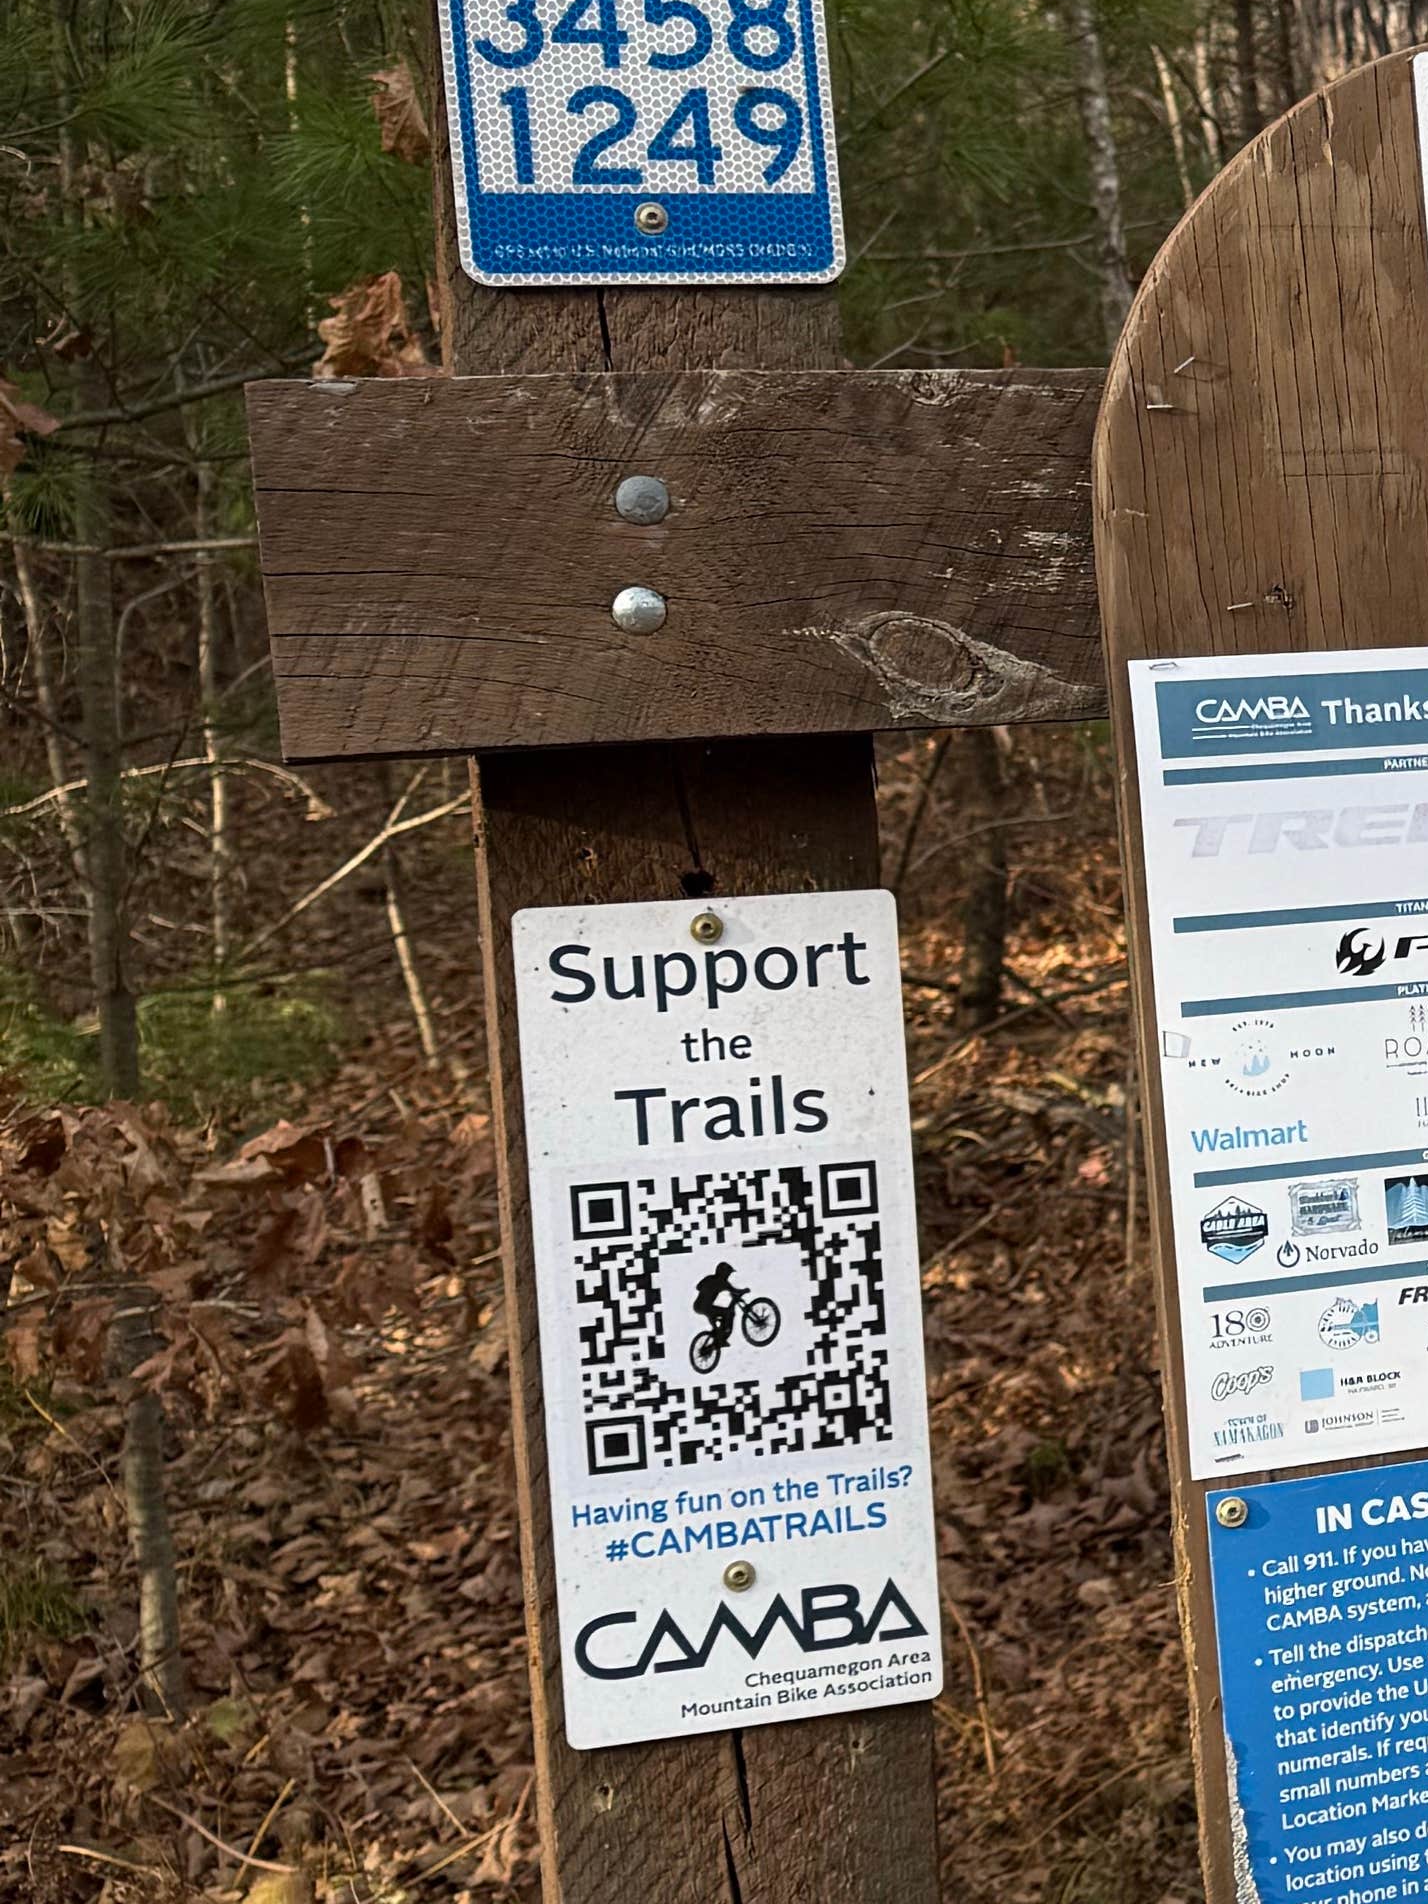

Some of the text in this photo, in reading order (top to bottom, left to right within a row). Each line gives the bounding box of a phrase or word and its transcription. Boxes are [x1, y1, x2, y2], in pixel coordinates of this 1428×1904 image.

[500, 84, 803, 186] 1249
[1195, 696, 1310, 724] CAMBA
[549, 932, 870, 1012] Support
[680, 1027, 751, 1062] the
[614, 1074, 828, 1145] Trails
[1192, 1120, 1308, 1154] Walmart
[1306, 1239, 1378, 1262] Norvado
[572, 1464, 912, 1527] Having fun on the Trails?
[605, 1501, 887, 1562] #CAMBATRAILS
[1316, 1503, 1352, 1533] IN
[1262, 1555, 1299, 1576] Call
[1303, 1550, 1338, 1570] 911.
[1343, 1545, 1357, 1564] If
[1361, 1544, 1396, 1566] you
[574, 1577, 928, 1680] CAMBA
[745, 1651, 931, 1687] Chequamegon Area
[681, 1671, 932, 1718] Mountain Bike Association
